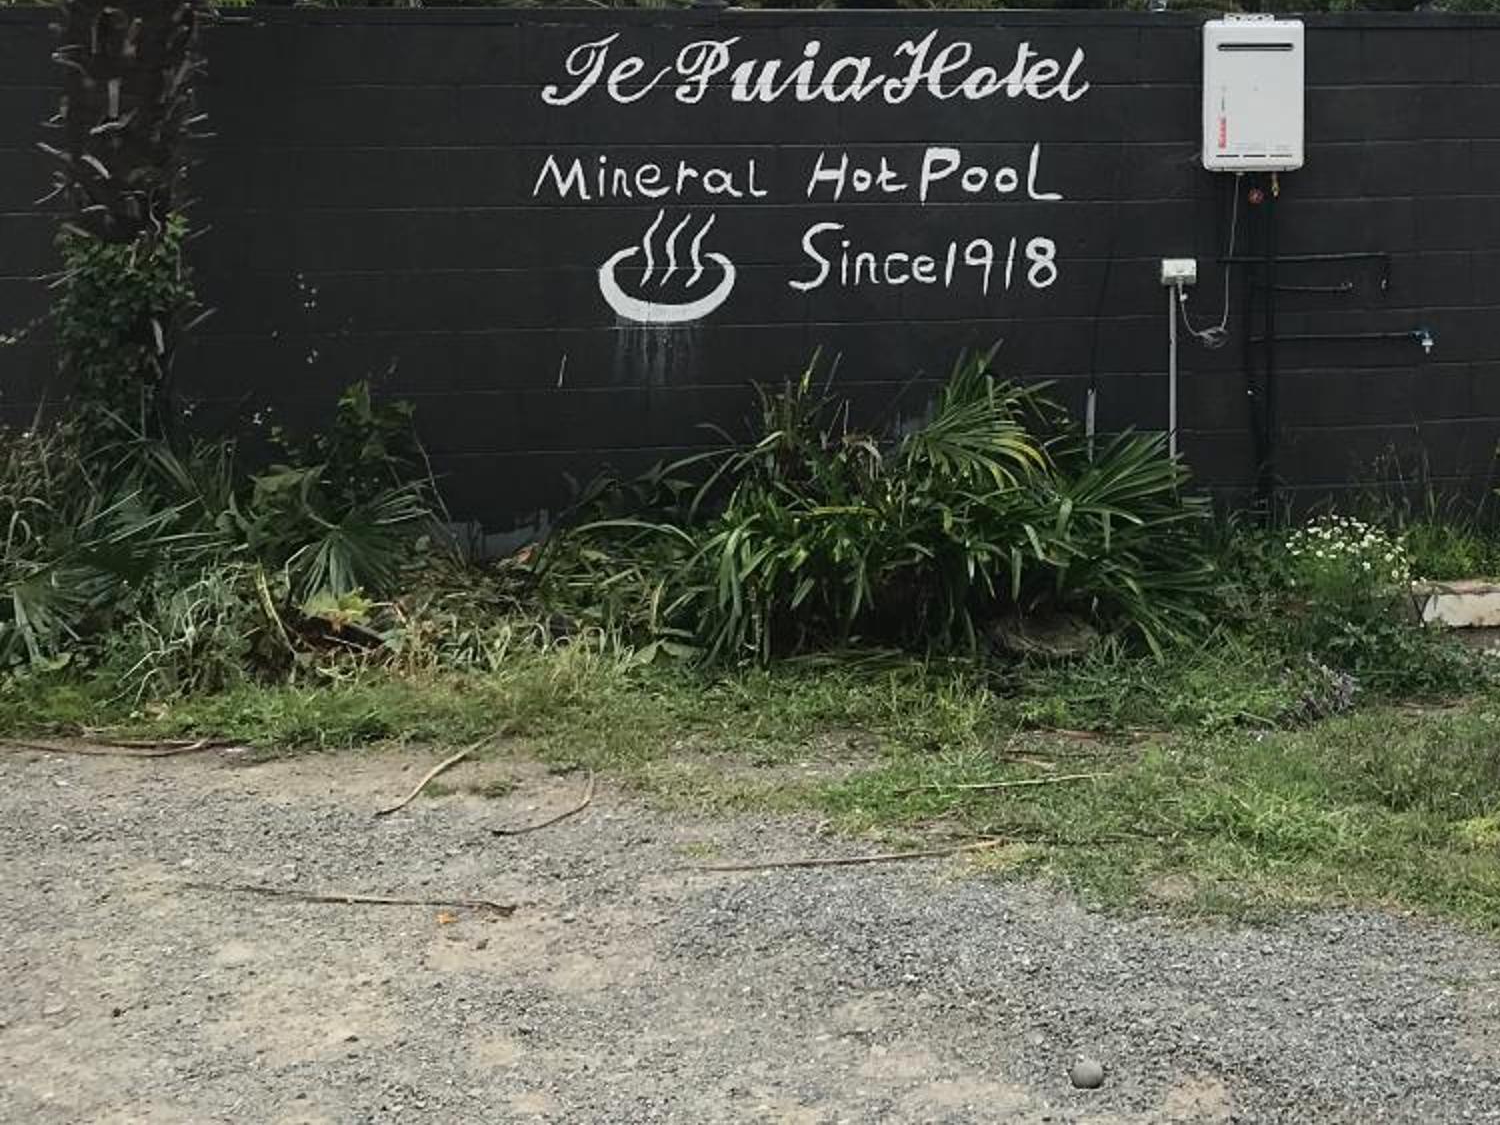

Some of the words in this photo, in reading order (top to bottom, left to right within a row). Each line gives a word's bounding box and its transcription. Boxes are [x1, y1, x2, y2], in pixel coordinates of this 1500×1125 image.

[541, 32, 673, 106] Te
[675, 36, 885, 104] Puia
[883, 28, 1090, 104] Hotel
[533, 154, 768, 201] Mineral
[807, 152, 908, 201] Hot
